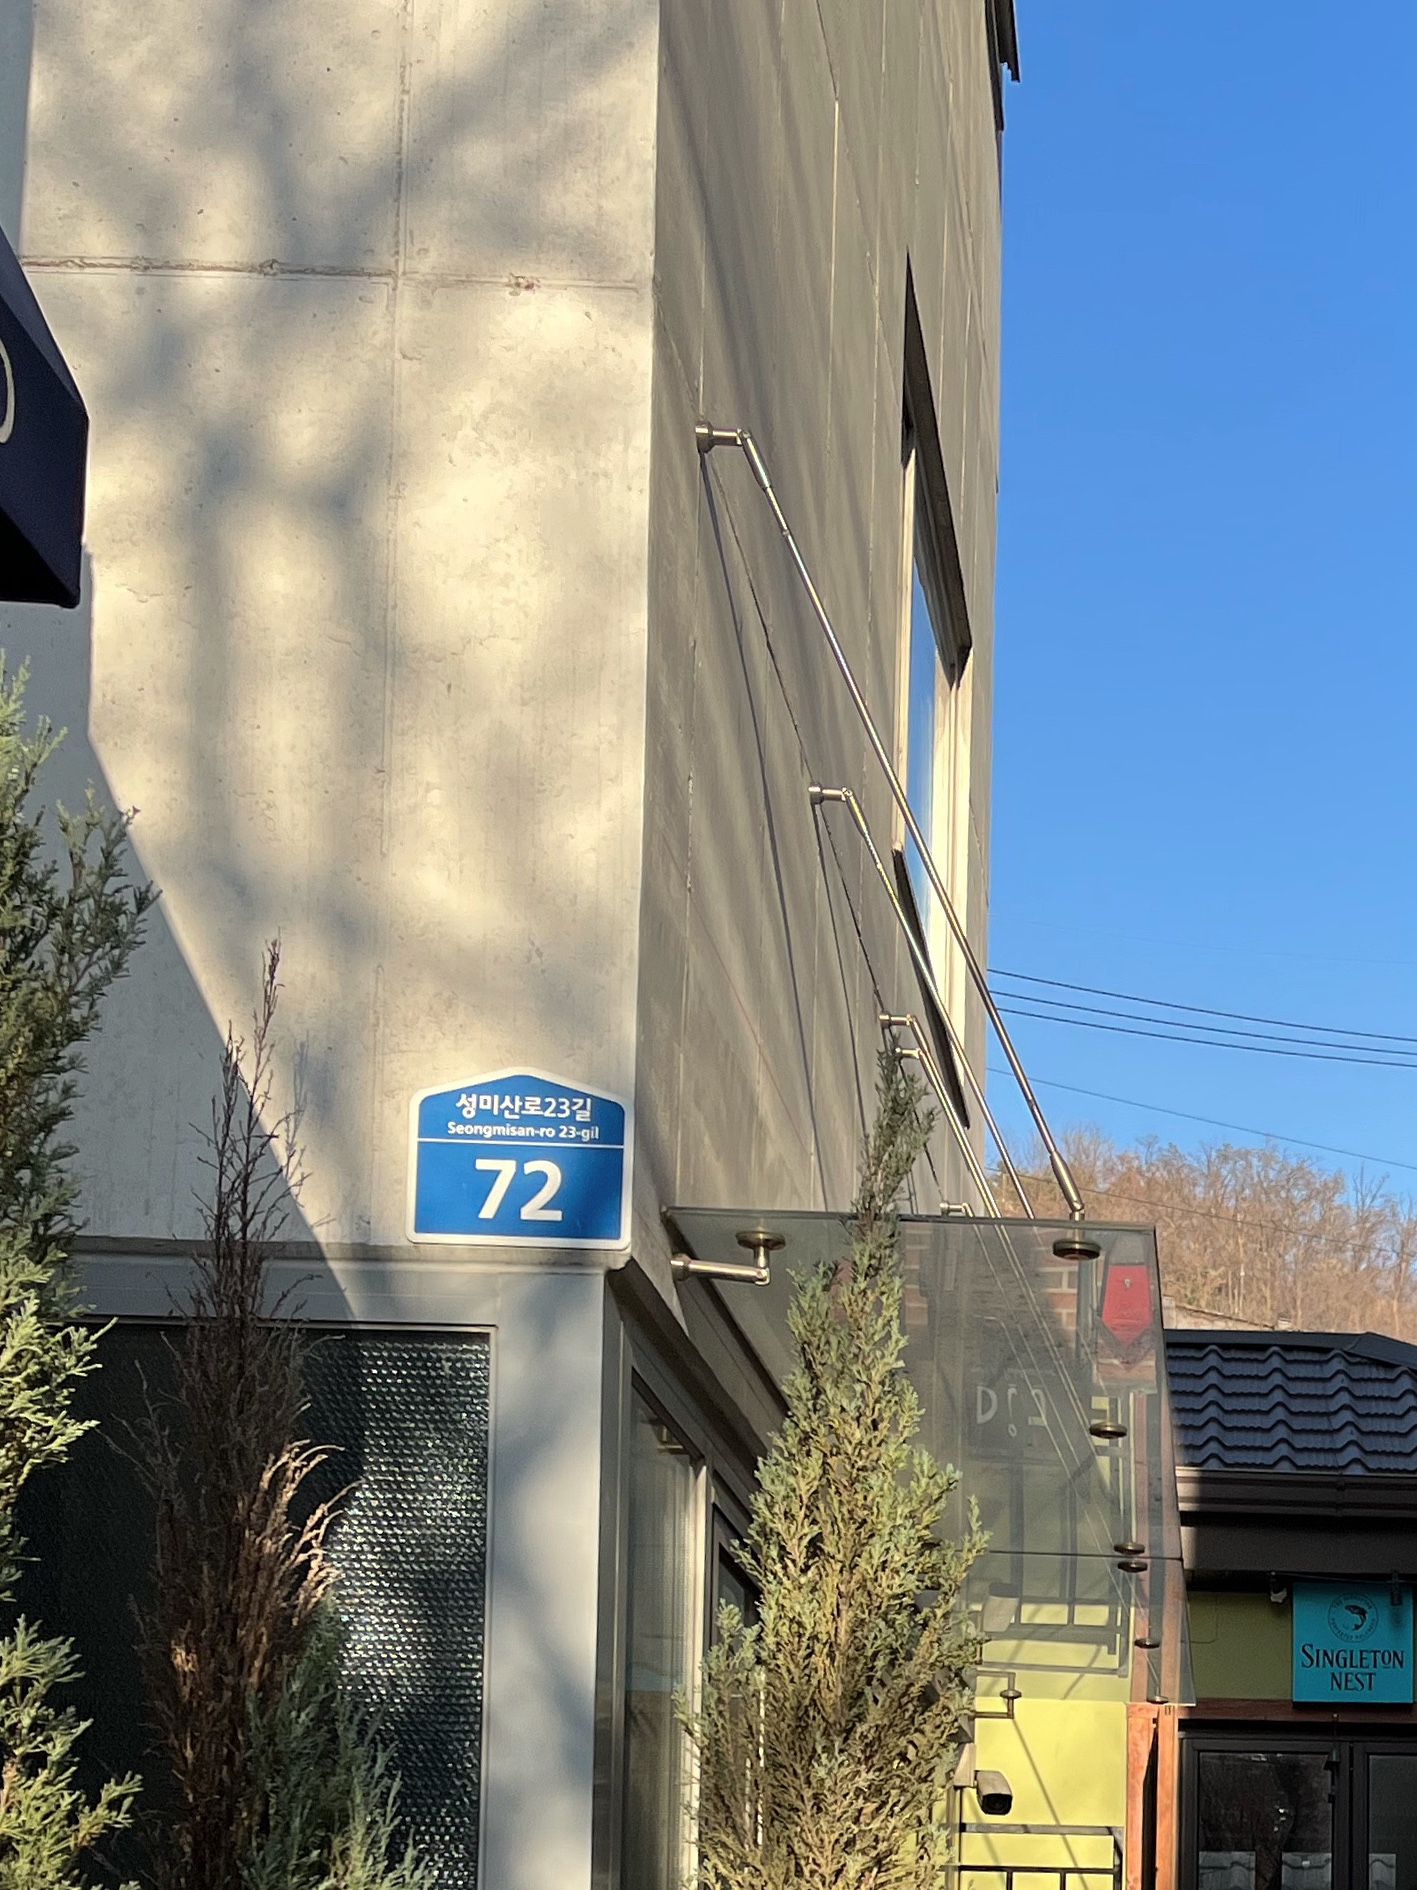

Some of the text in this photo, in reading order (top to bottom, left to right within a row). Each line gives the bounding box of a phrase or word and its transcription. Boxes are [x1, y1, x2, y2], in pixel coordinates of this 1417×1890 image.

[455, 1093, 592, 1122] 성미산로23길
[447, 1122, 599, 1142] Seongmisan-ro 23-gil
[475, 1158, 563, 1222] 72
[1301, 1643, 1404, 1669] SINGLETON
[1330, 1672, 1377, 1692] NEST
